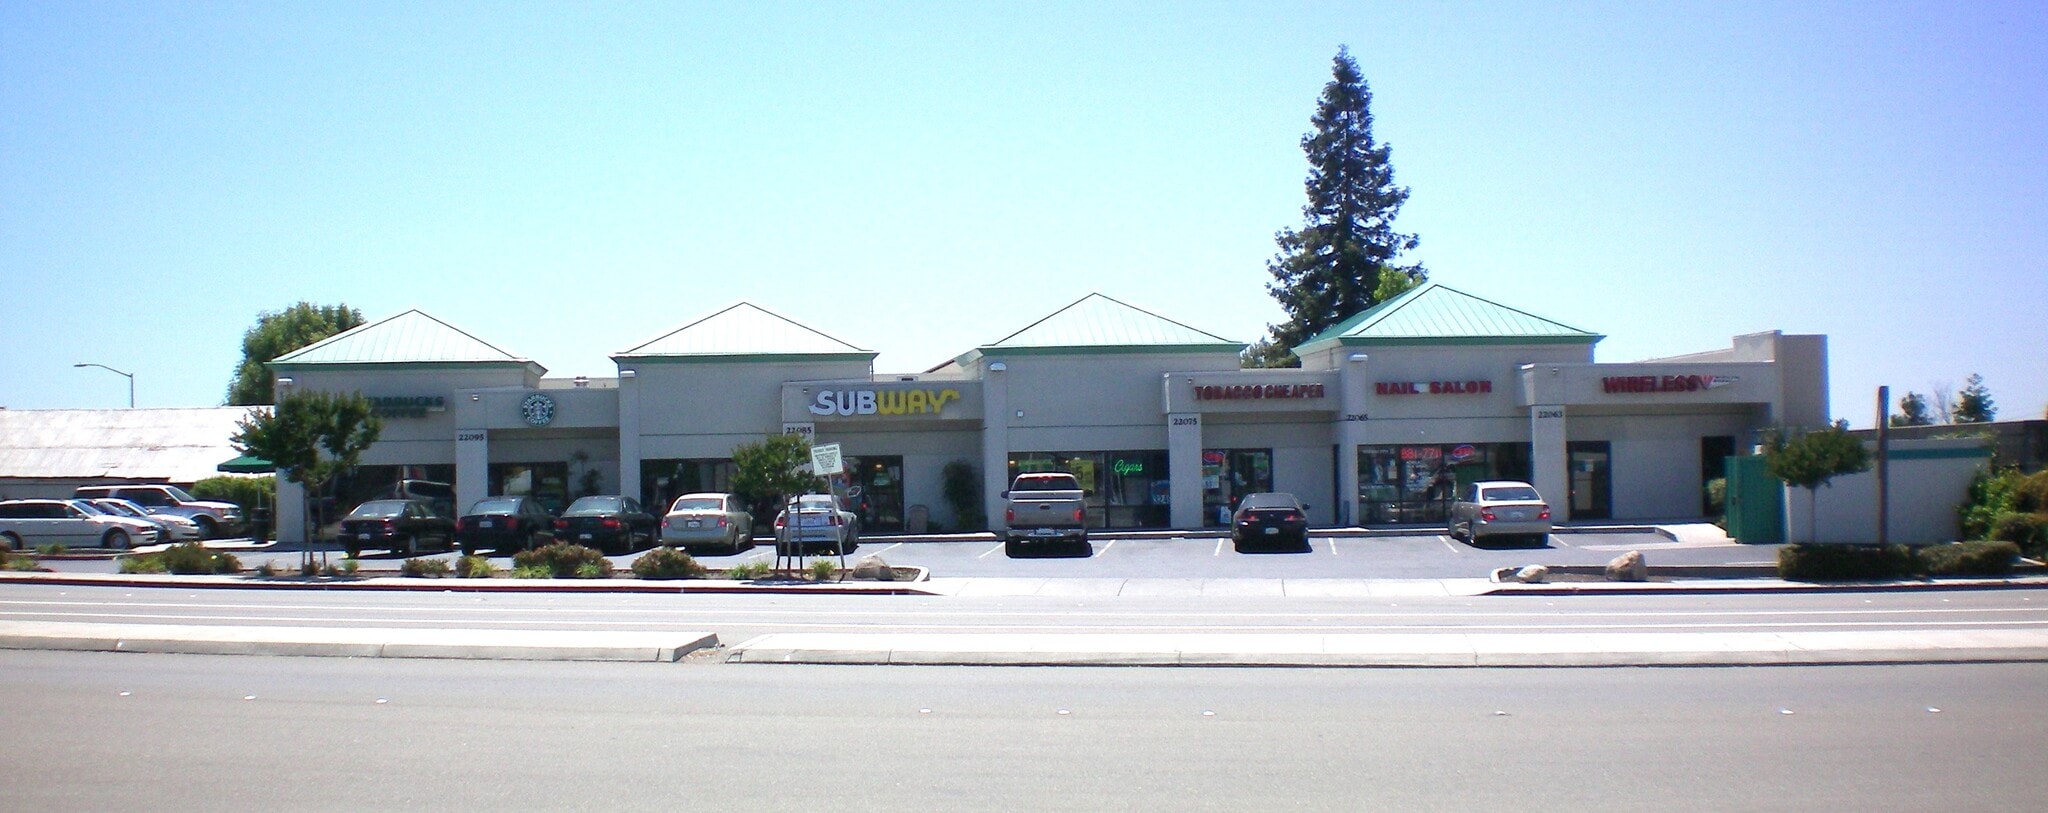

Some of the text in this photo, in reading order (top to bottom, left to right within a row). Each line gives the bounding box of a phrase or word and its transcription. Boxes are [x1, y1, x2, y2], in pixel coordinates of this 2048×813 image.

[1194, 384, 1325, 400] TOBACCO CHEAPER
[1374, 380, 1492, 395] NAIL SALON
[1602, 375, 1697, 393] WIRELESS
[808, 389, 960, 416] SUBWAY
[1172, 417, 1198, 426] 22075
[1537, 410, 1563, 419] 22063
[1114, 459, 1143, 476] Cigars
